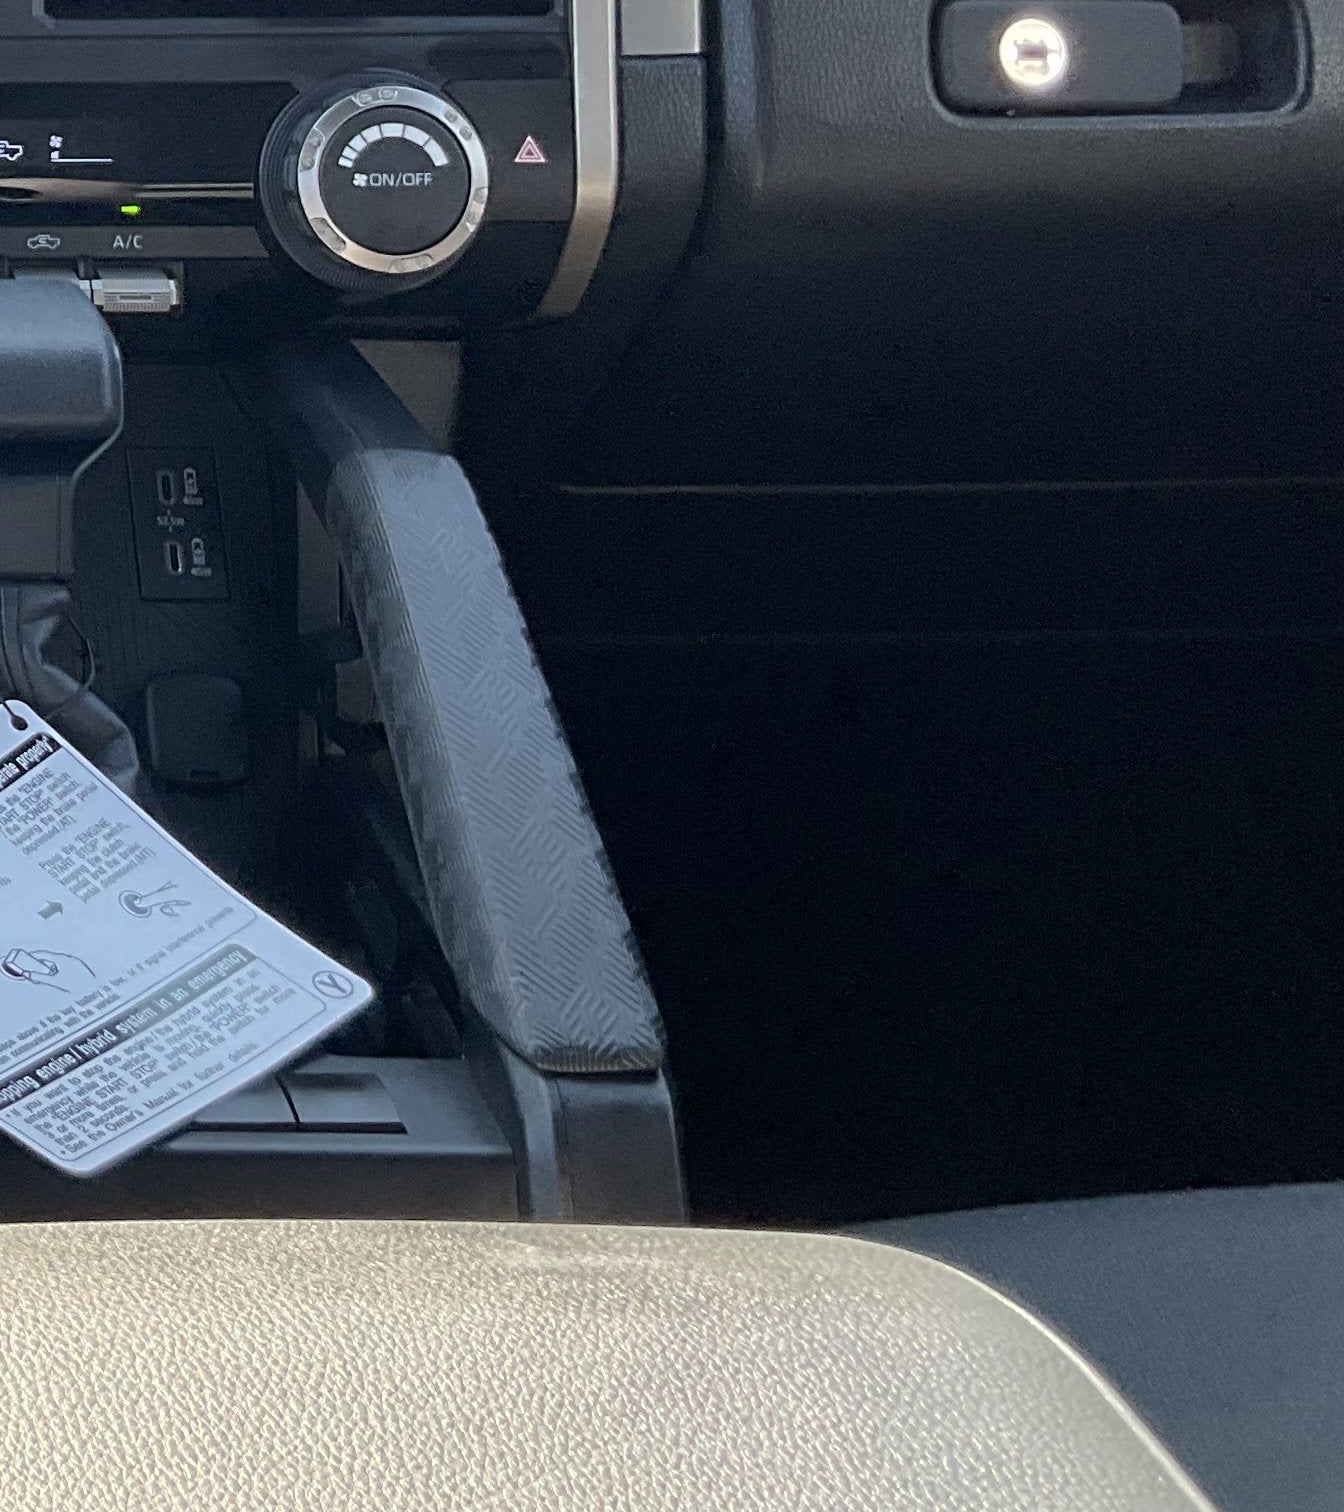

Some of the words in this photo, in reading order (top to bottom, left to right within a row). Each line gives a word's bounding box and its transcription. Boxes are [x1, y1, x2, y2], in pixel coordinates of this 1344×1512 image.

[369, 172, 433, 187] ON/OFF
[112, 234, 144, 251] A/C
[75, 1029, 116, 1054] hybrid
[115, 1007, 157, 1034] system
[153, 997, 172, 1010] in
[169, 987, 188, 1001] an
[187, 951, 247, 989] emergency
[95, 1077, 128, 1098] START
